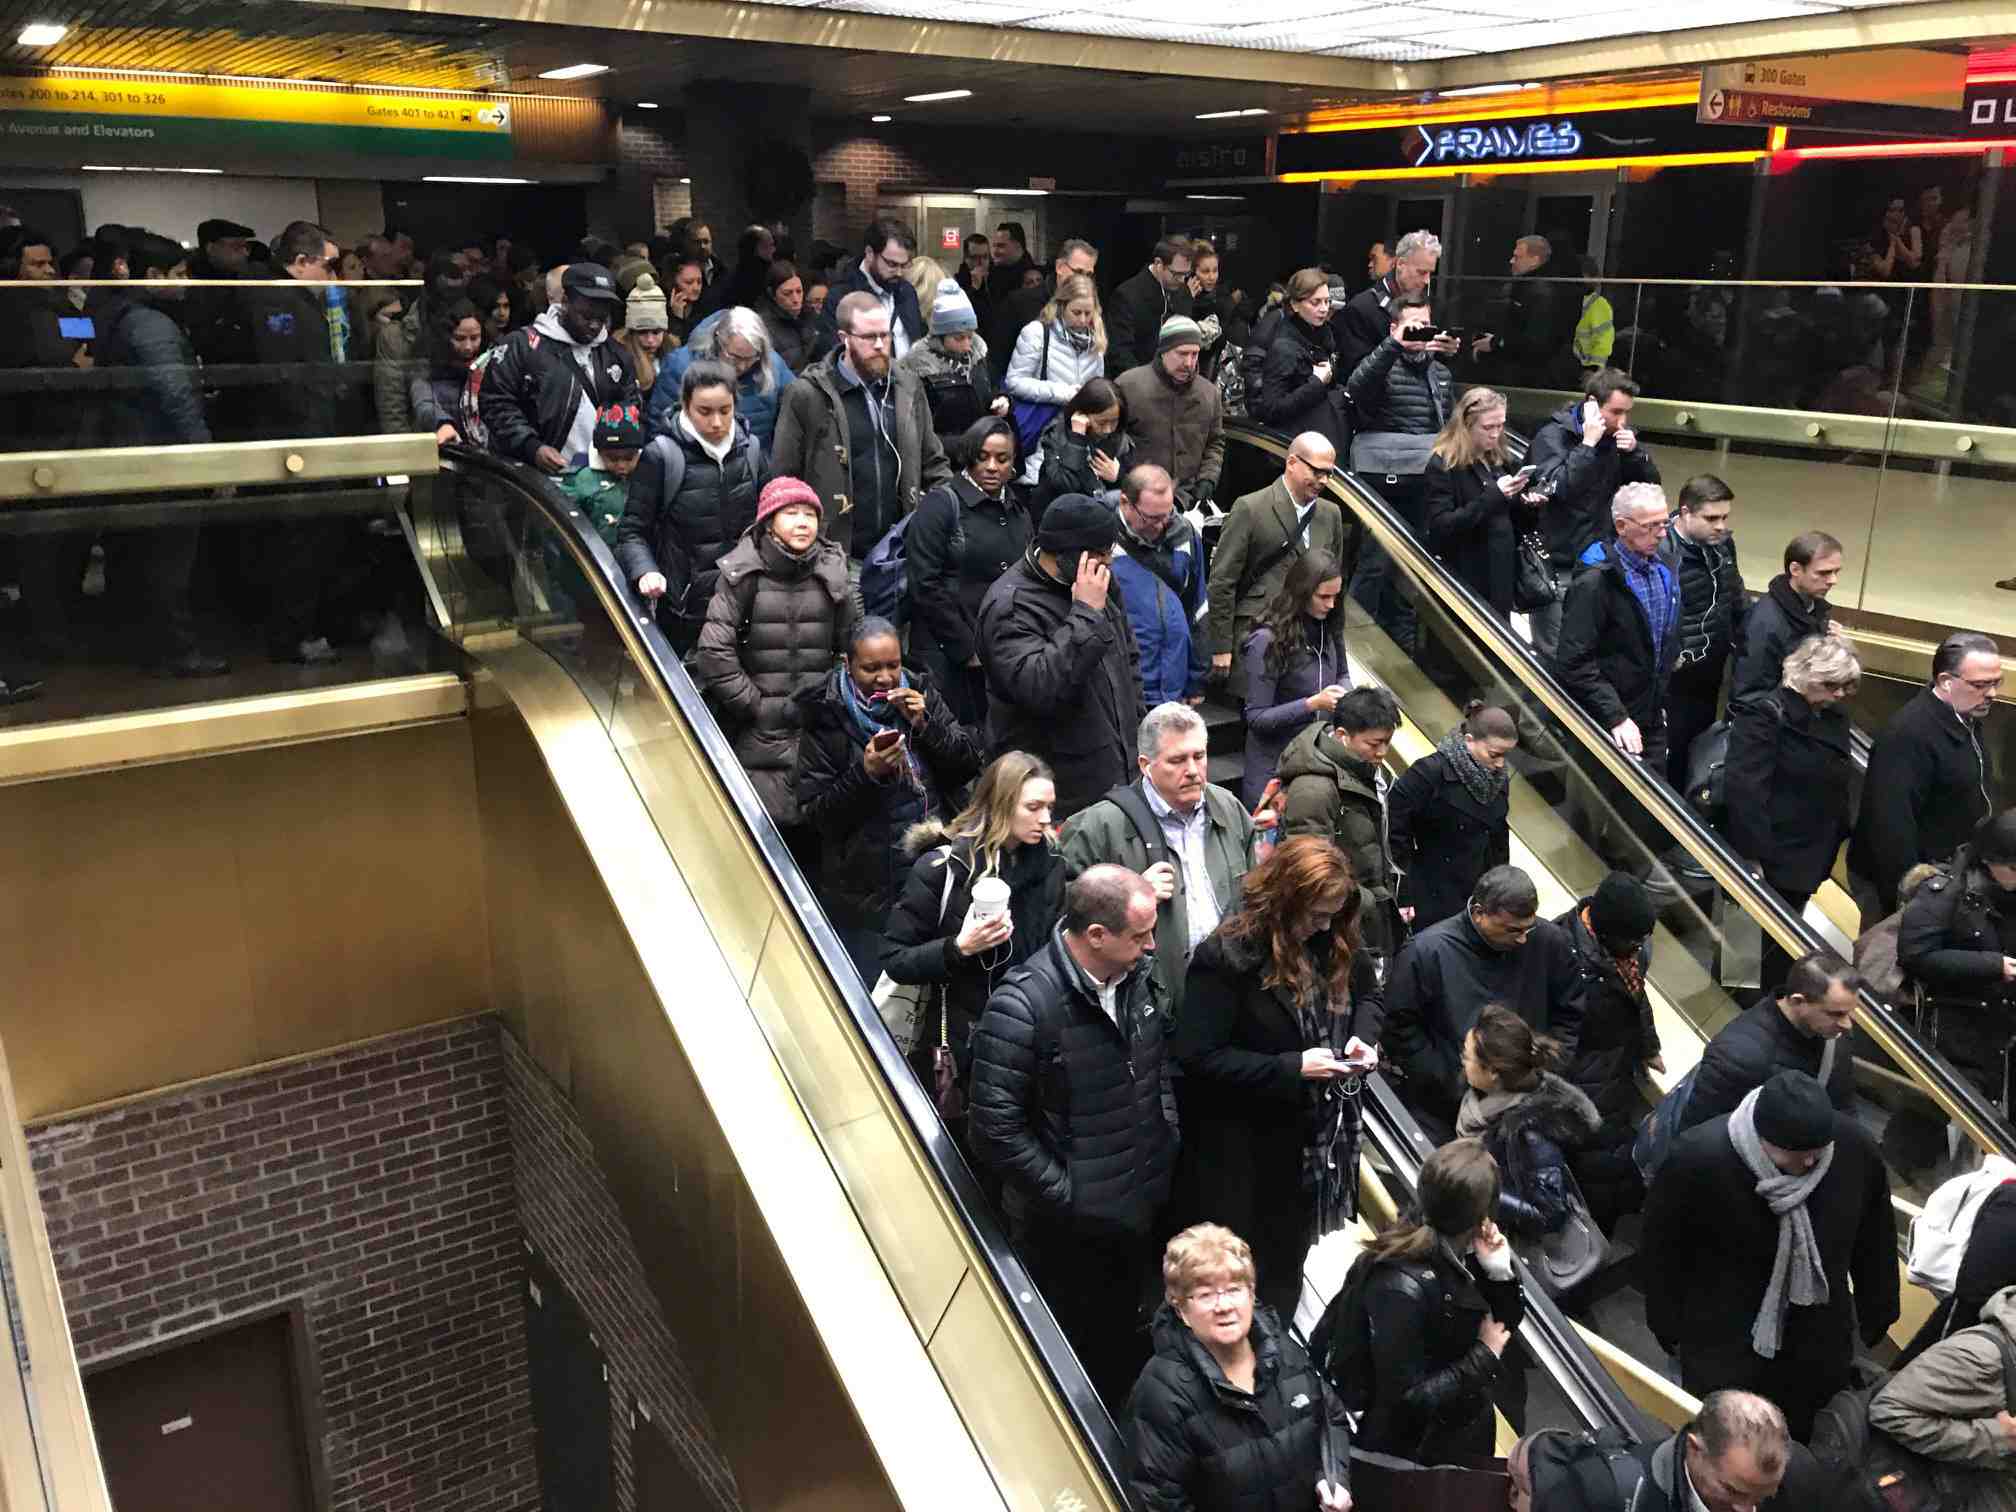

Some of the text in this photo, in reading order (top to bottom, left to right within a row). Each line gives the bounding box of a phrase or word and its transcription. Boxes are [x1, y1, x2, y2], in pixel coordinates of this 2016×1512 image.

[1779, 69, 1807, 87] Gates
[0, 87, 24, 99] ates
[127, 92, 141, 104] to
[143, 94, 167, 105] 326
[367, 105, 399, 118] Gates
[401, 107, 420, 119] 401
[423, 109, 435, 120] to
[1760, 99, 1811, 119] Restrooms
[9, 121, 60, 136] Avenue
[63, 122, 90, 137] and
[93, 123, 156, 138] Elevators
[1435, 120, 1581, 160] FRAMES
